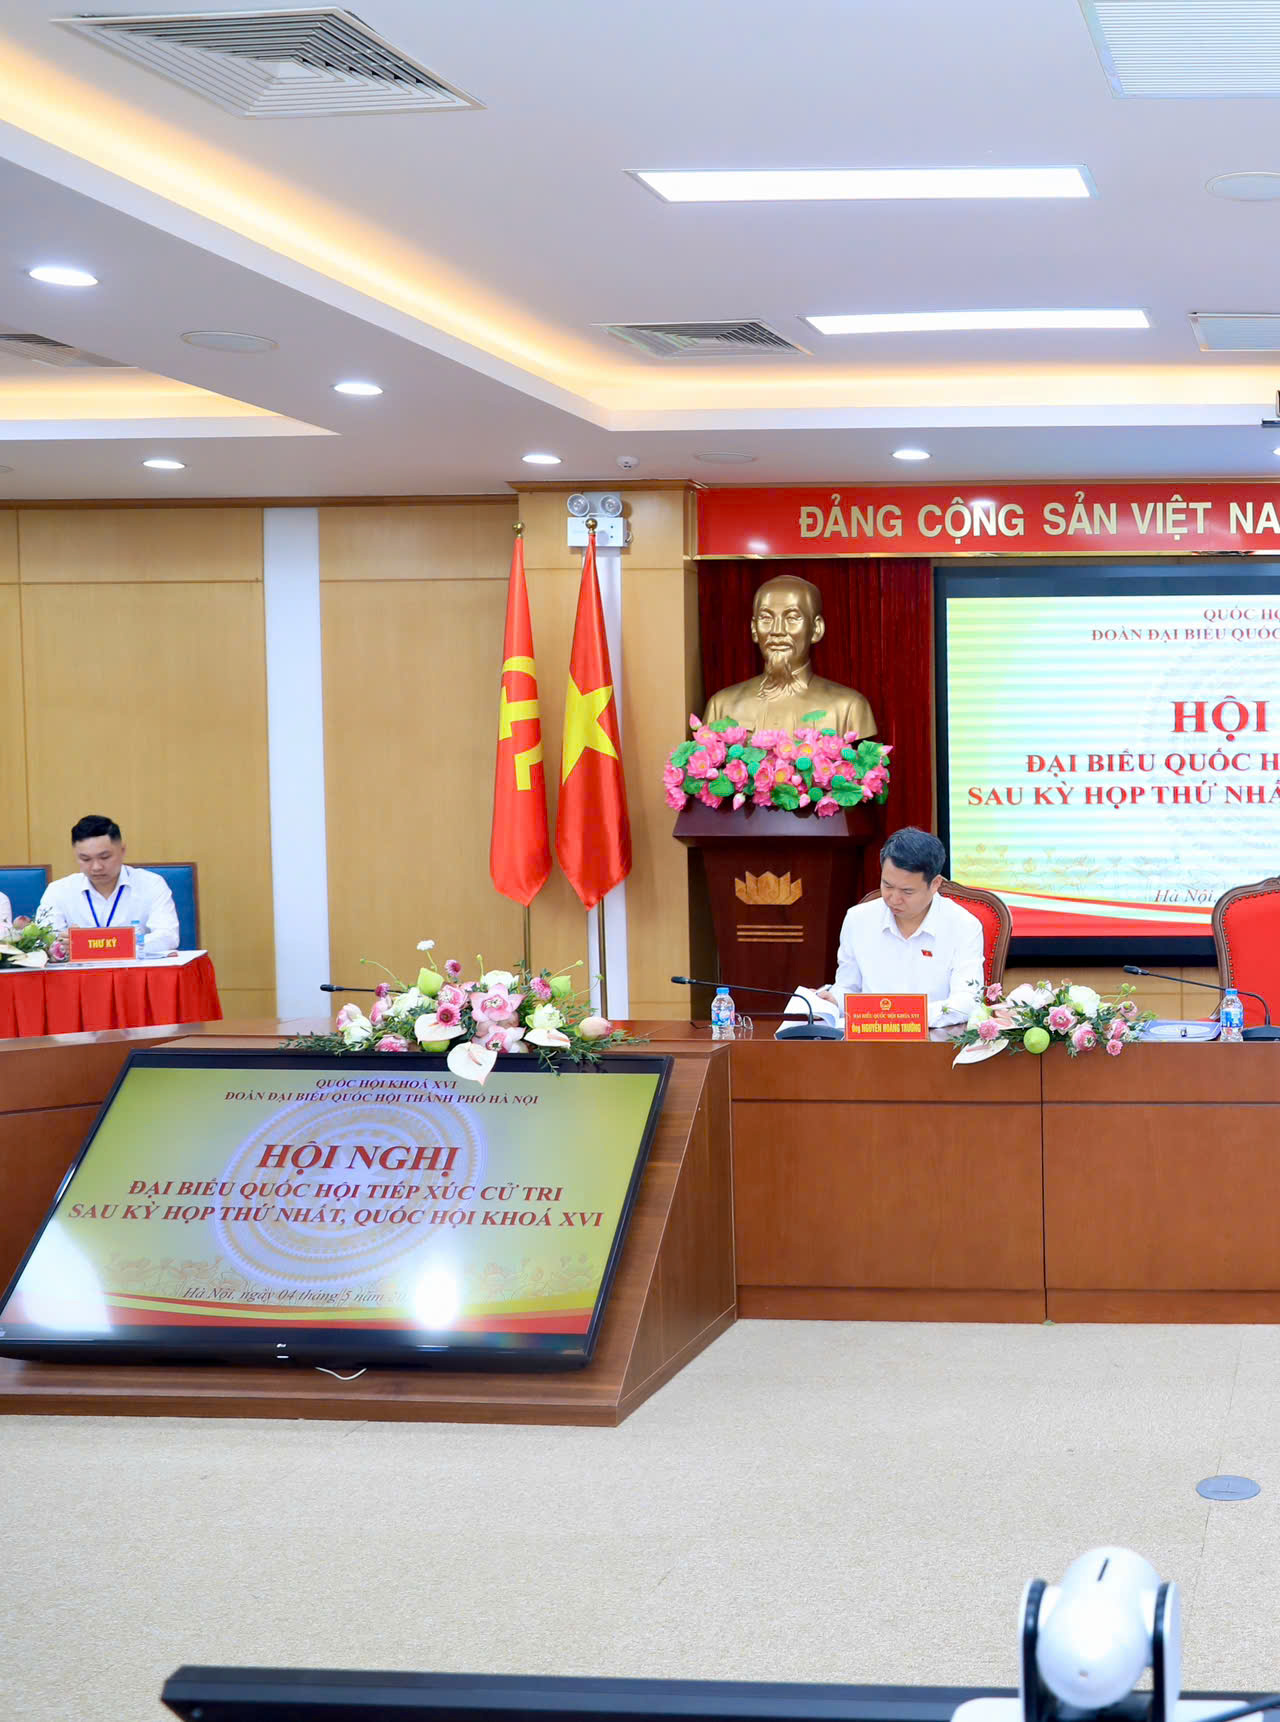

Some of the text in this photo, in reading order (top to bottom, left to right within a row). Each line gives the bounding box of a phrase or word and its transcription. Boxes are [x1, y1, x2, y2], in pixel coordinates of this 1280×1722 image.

[799, 493, 903, 538] ĐẢNG
[917, 496, 1025, 544] CỘNG
[1043, 490, 1117, 536] SẢN
[1130, 494, 1212, 541] VIỆT
[1091, 624, 1142, 641] ĐOÀN
[1148, 628, 1178, 643] ĐẠI
[1171, 695, 1269, 743] HỘI
[1026, 754, 1079, 778] ĐẠI
[1087, 748, 1155, 773] BIỂU
[1165, 747, 1251, 777] QUỐC
[967, 786, 1024, 806] SAU
[1034, 780, 1075, 806] KỲ
[1085, 785, 1146, 809] HỌP
[1150, 780, 1218, 804] THỨ
[1154, 889, 1179, 902] Hà
[388, 1078, 428, 1089] KHOÁ
[431, 1080, 457, 1089] XVI
[224, 1089, 265, 1101] ĐOÀN
[268, 1092, 292, 1103] ĐẠI
[405, 1092, 456, 1104] THÀNH
[489, 1092, 509, 1104] HÀ
[512, 1094, 539, 1106] NỘI
[255, 1140, 463, 1177] HỘI NGHỊ
[128, 1177, 564, 1202] ĐẠI BIỂU QUỐC HỘI TIẾP XÚC CỬ TRI
[68, 1200, 605, 1229] SAU KỲ HỌP THỨ NHẤT, QUỐC HỘI KHOÁ XVI
[182, 1287, 205, 1299] Hà
[278, 1289, 298, 1300] 04
[299, 1289, 338, 1303] tháng
